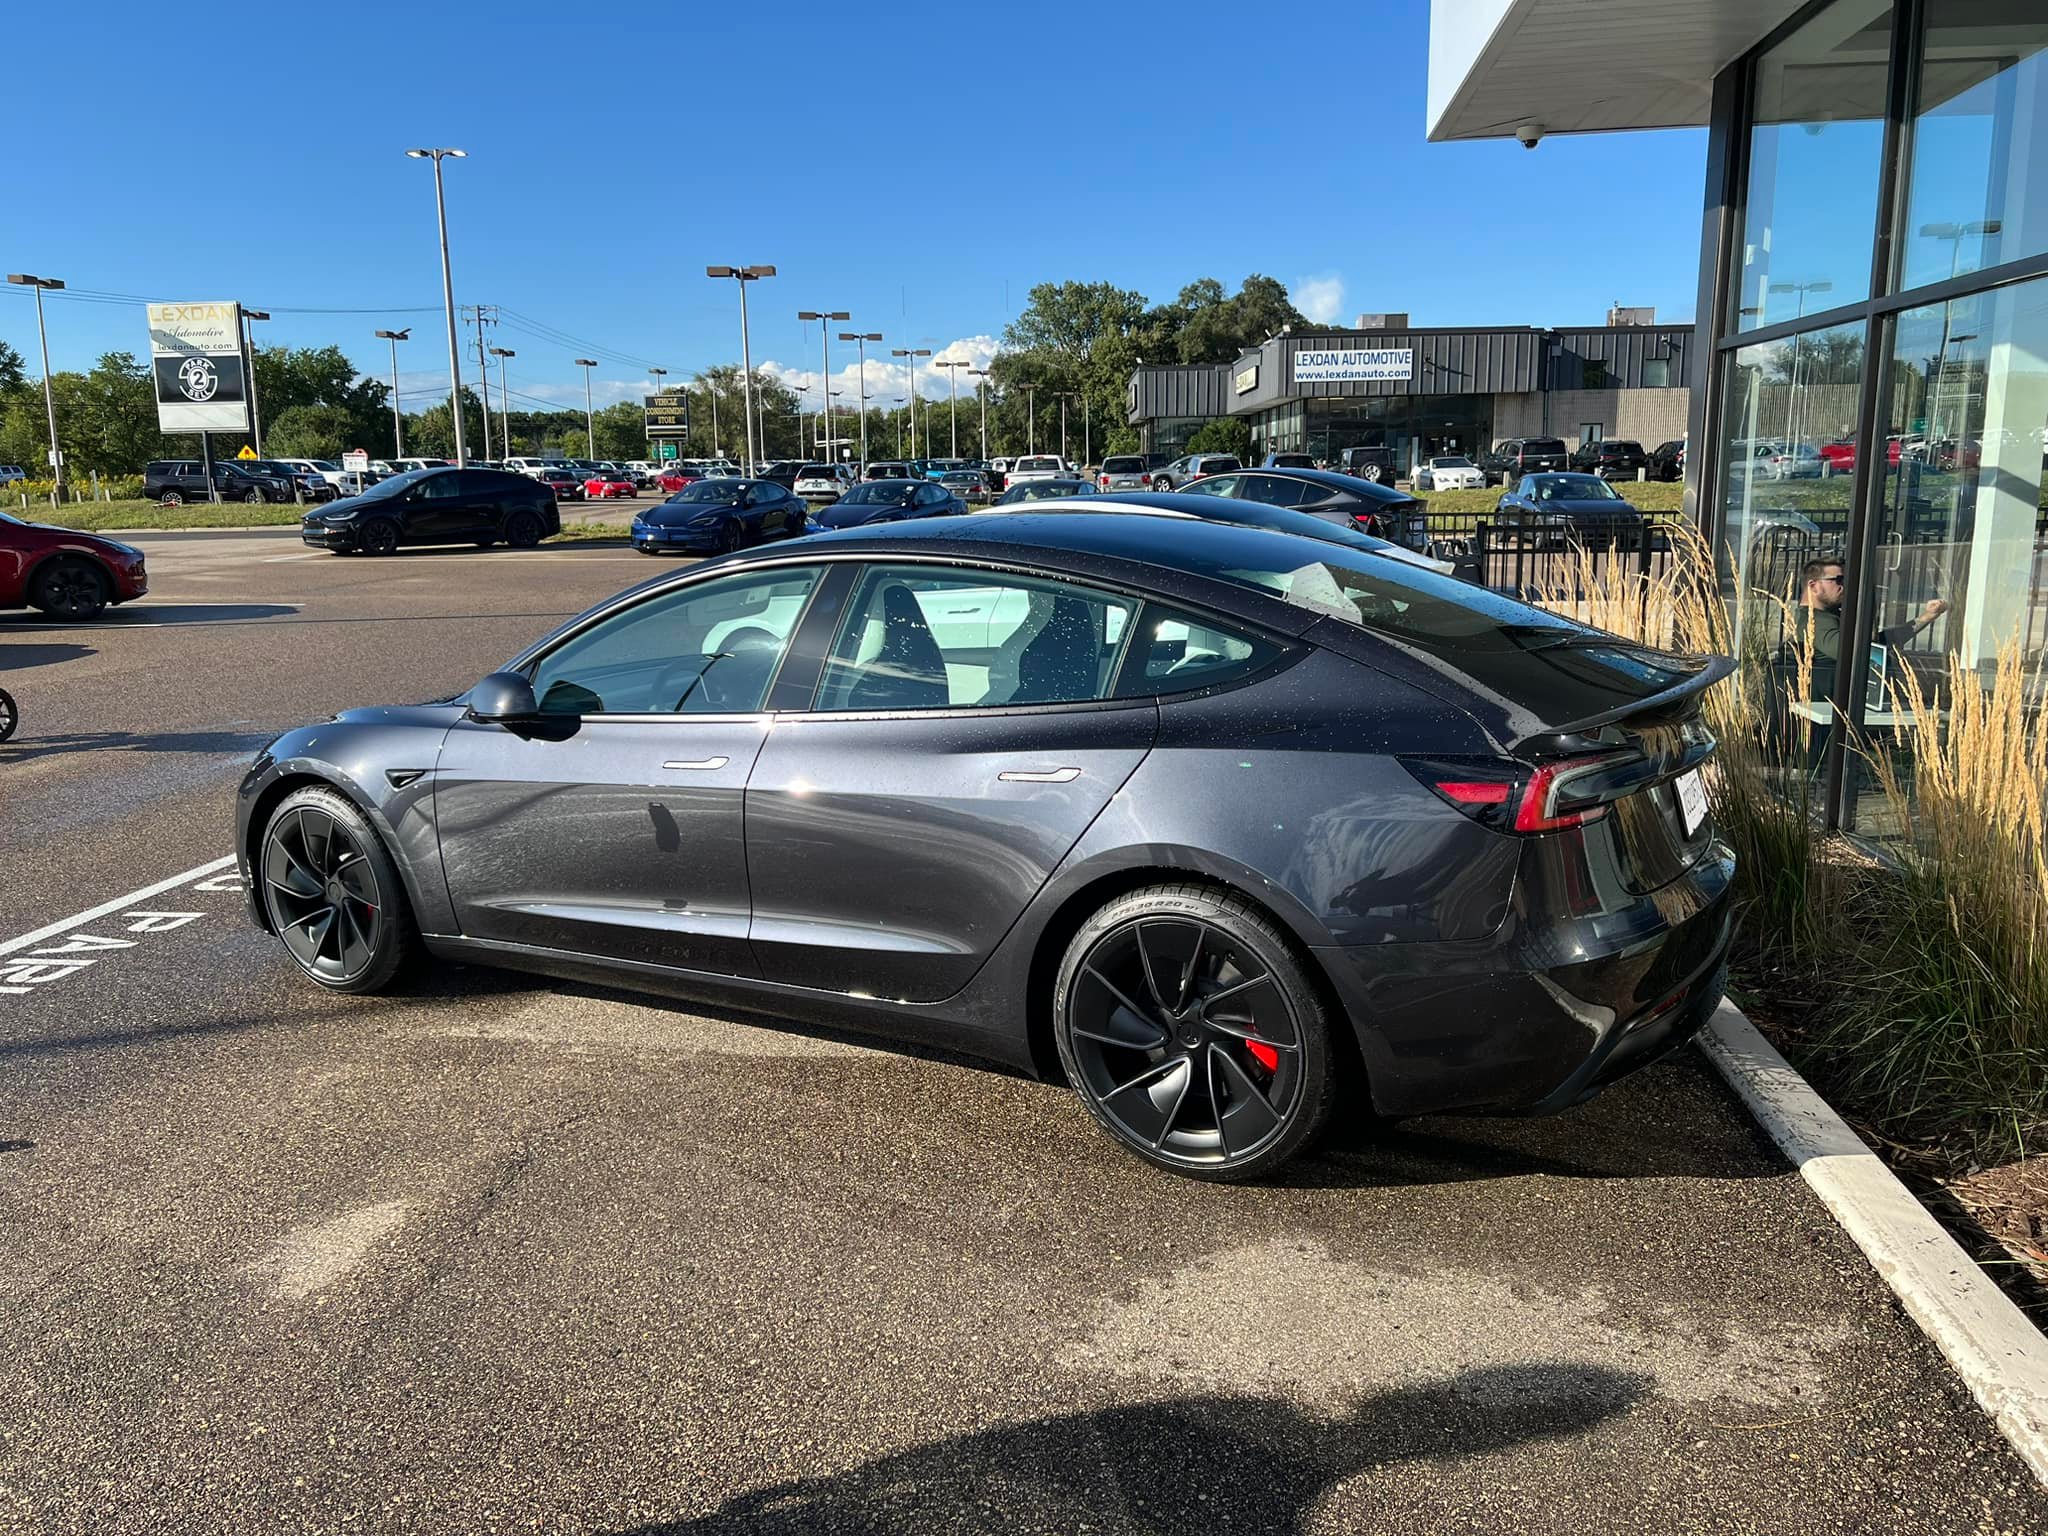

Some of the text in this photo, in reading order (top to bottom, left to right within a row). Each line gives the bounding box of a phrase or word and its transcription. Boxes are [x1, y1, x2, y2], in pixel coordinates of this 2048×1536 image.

[150, 305, 233, 322] LEXDAN
[163, 326, 224, 337] Automotive
[159, 343, 233, 351] lexdanauto.com
[1296, 351, 1411, 366] LEXDAN AUTOMOTIVE
[185, 359, 210, 370] PARK
[193, 371, 204, 386] 2
[1295, 369, 1410, 379] www.lexdanauto.com
[188, 389, 211, 399] SELL
[654, 398, 678, 406] VEHICLE
[0, 911, 208, 994] PAR
